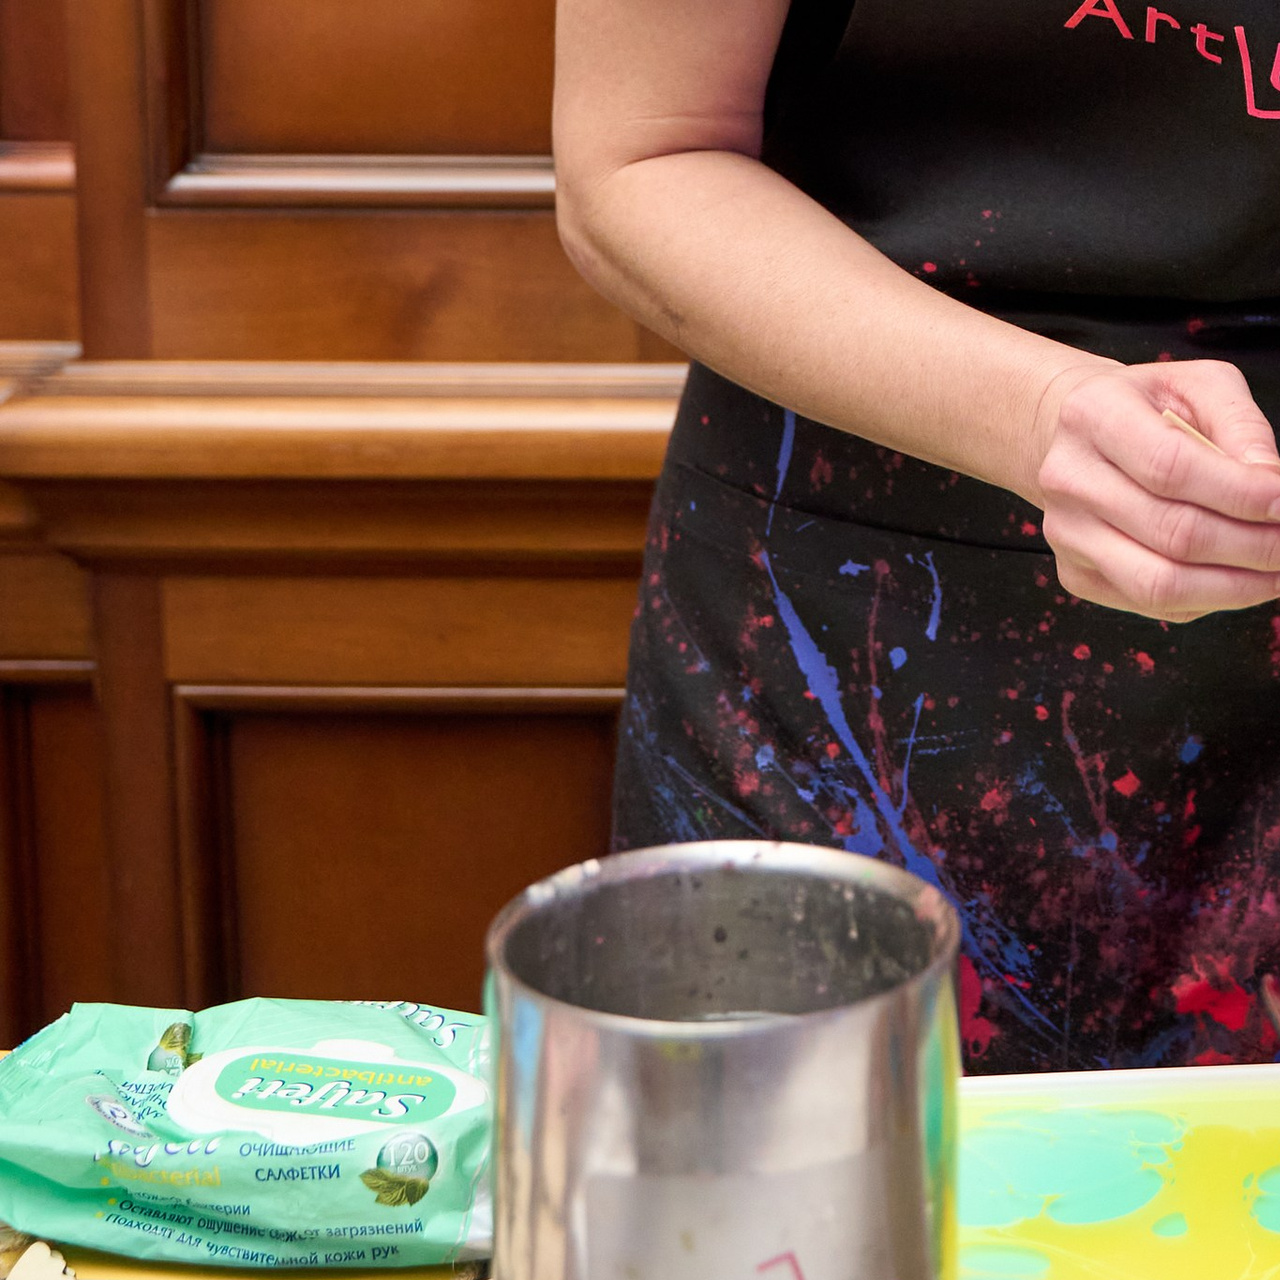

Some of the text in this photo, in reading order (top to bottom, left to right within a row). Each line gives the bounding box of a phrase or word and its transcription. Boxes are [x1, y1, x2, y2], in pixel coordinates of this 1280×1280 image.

[251, 1058, 432, 1087] antibacterial
[231, 1077, 426, 1118] Salfeti
[387, 1142, 429, 1167] 120
[255, 1164, 340, 1182] САЛФЕТКИ
[119, 1199, 195, 1226] Оставляют
[105, 1213, 176, 1239] Подходят
[176, 1232, 203, 1248] для
[324, 1249, 366, 1264] кожи
[371, 1245, 399, 1260] рук
[325, 1218, 423, 1239] загрязнений
